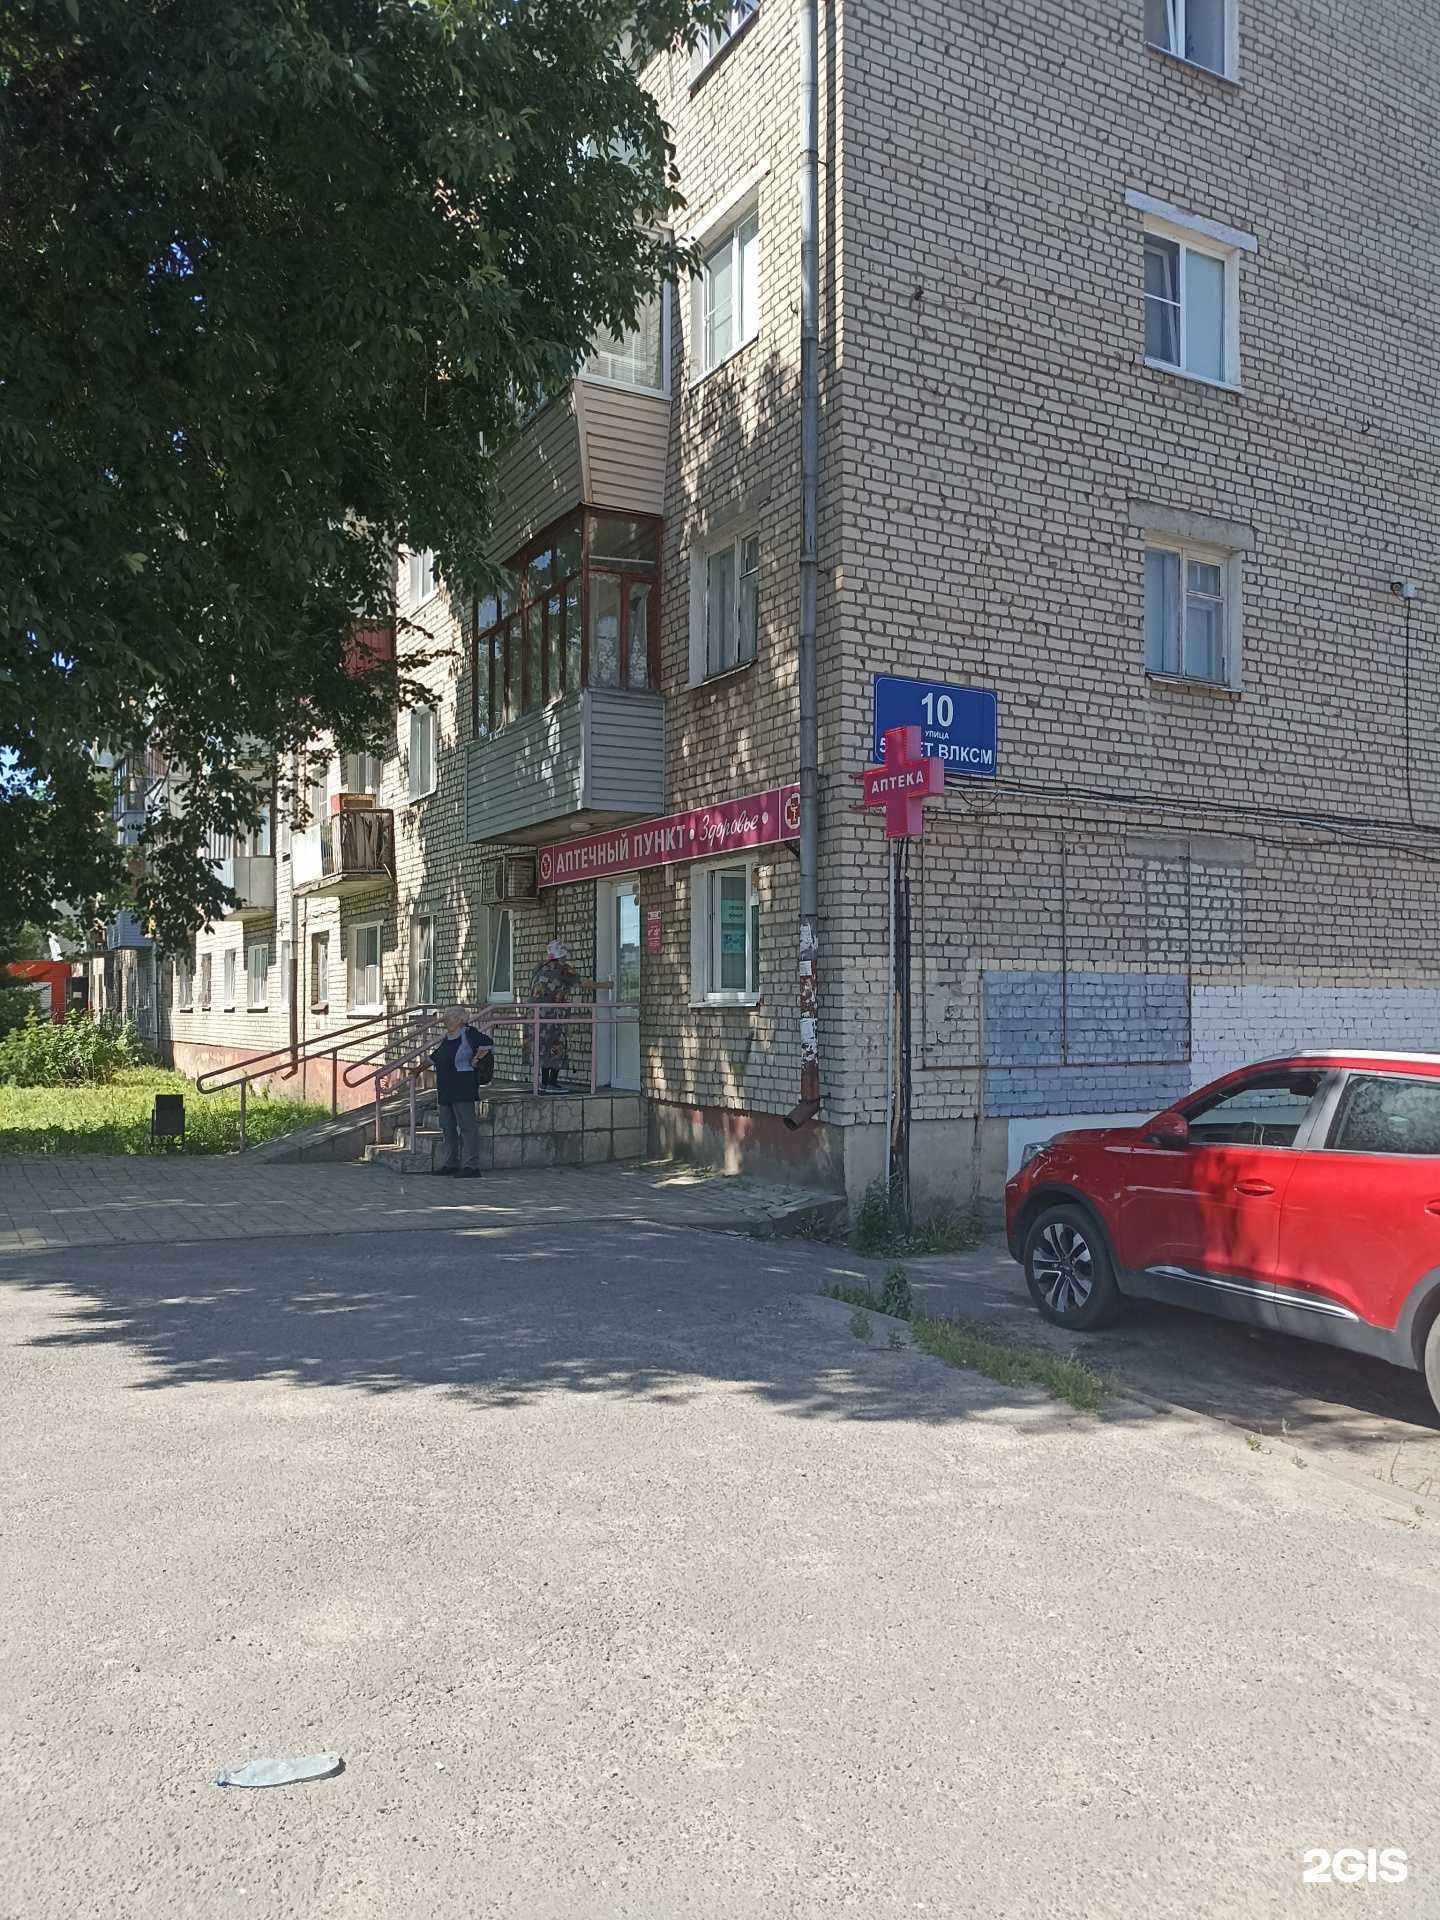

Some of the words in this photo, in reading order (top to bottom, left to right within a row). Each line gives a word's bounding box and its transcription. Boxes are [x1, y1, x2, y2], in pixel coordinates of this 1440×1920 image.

[921, 692, 954, 727] 10
[925, 731, 949, 740] УЛИЦА
[938, 746, 992, 764] ВЛКСМ
[871, 769, 924, 794] АПТЕКА
[556, 832, 629, 873] АПТЕЧНЫЙ
[633, 824, 686, 858] ПУНКТ
[699, 810, 759, 847] Здоровье
